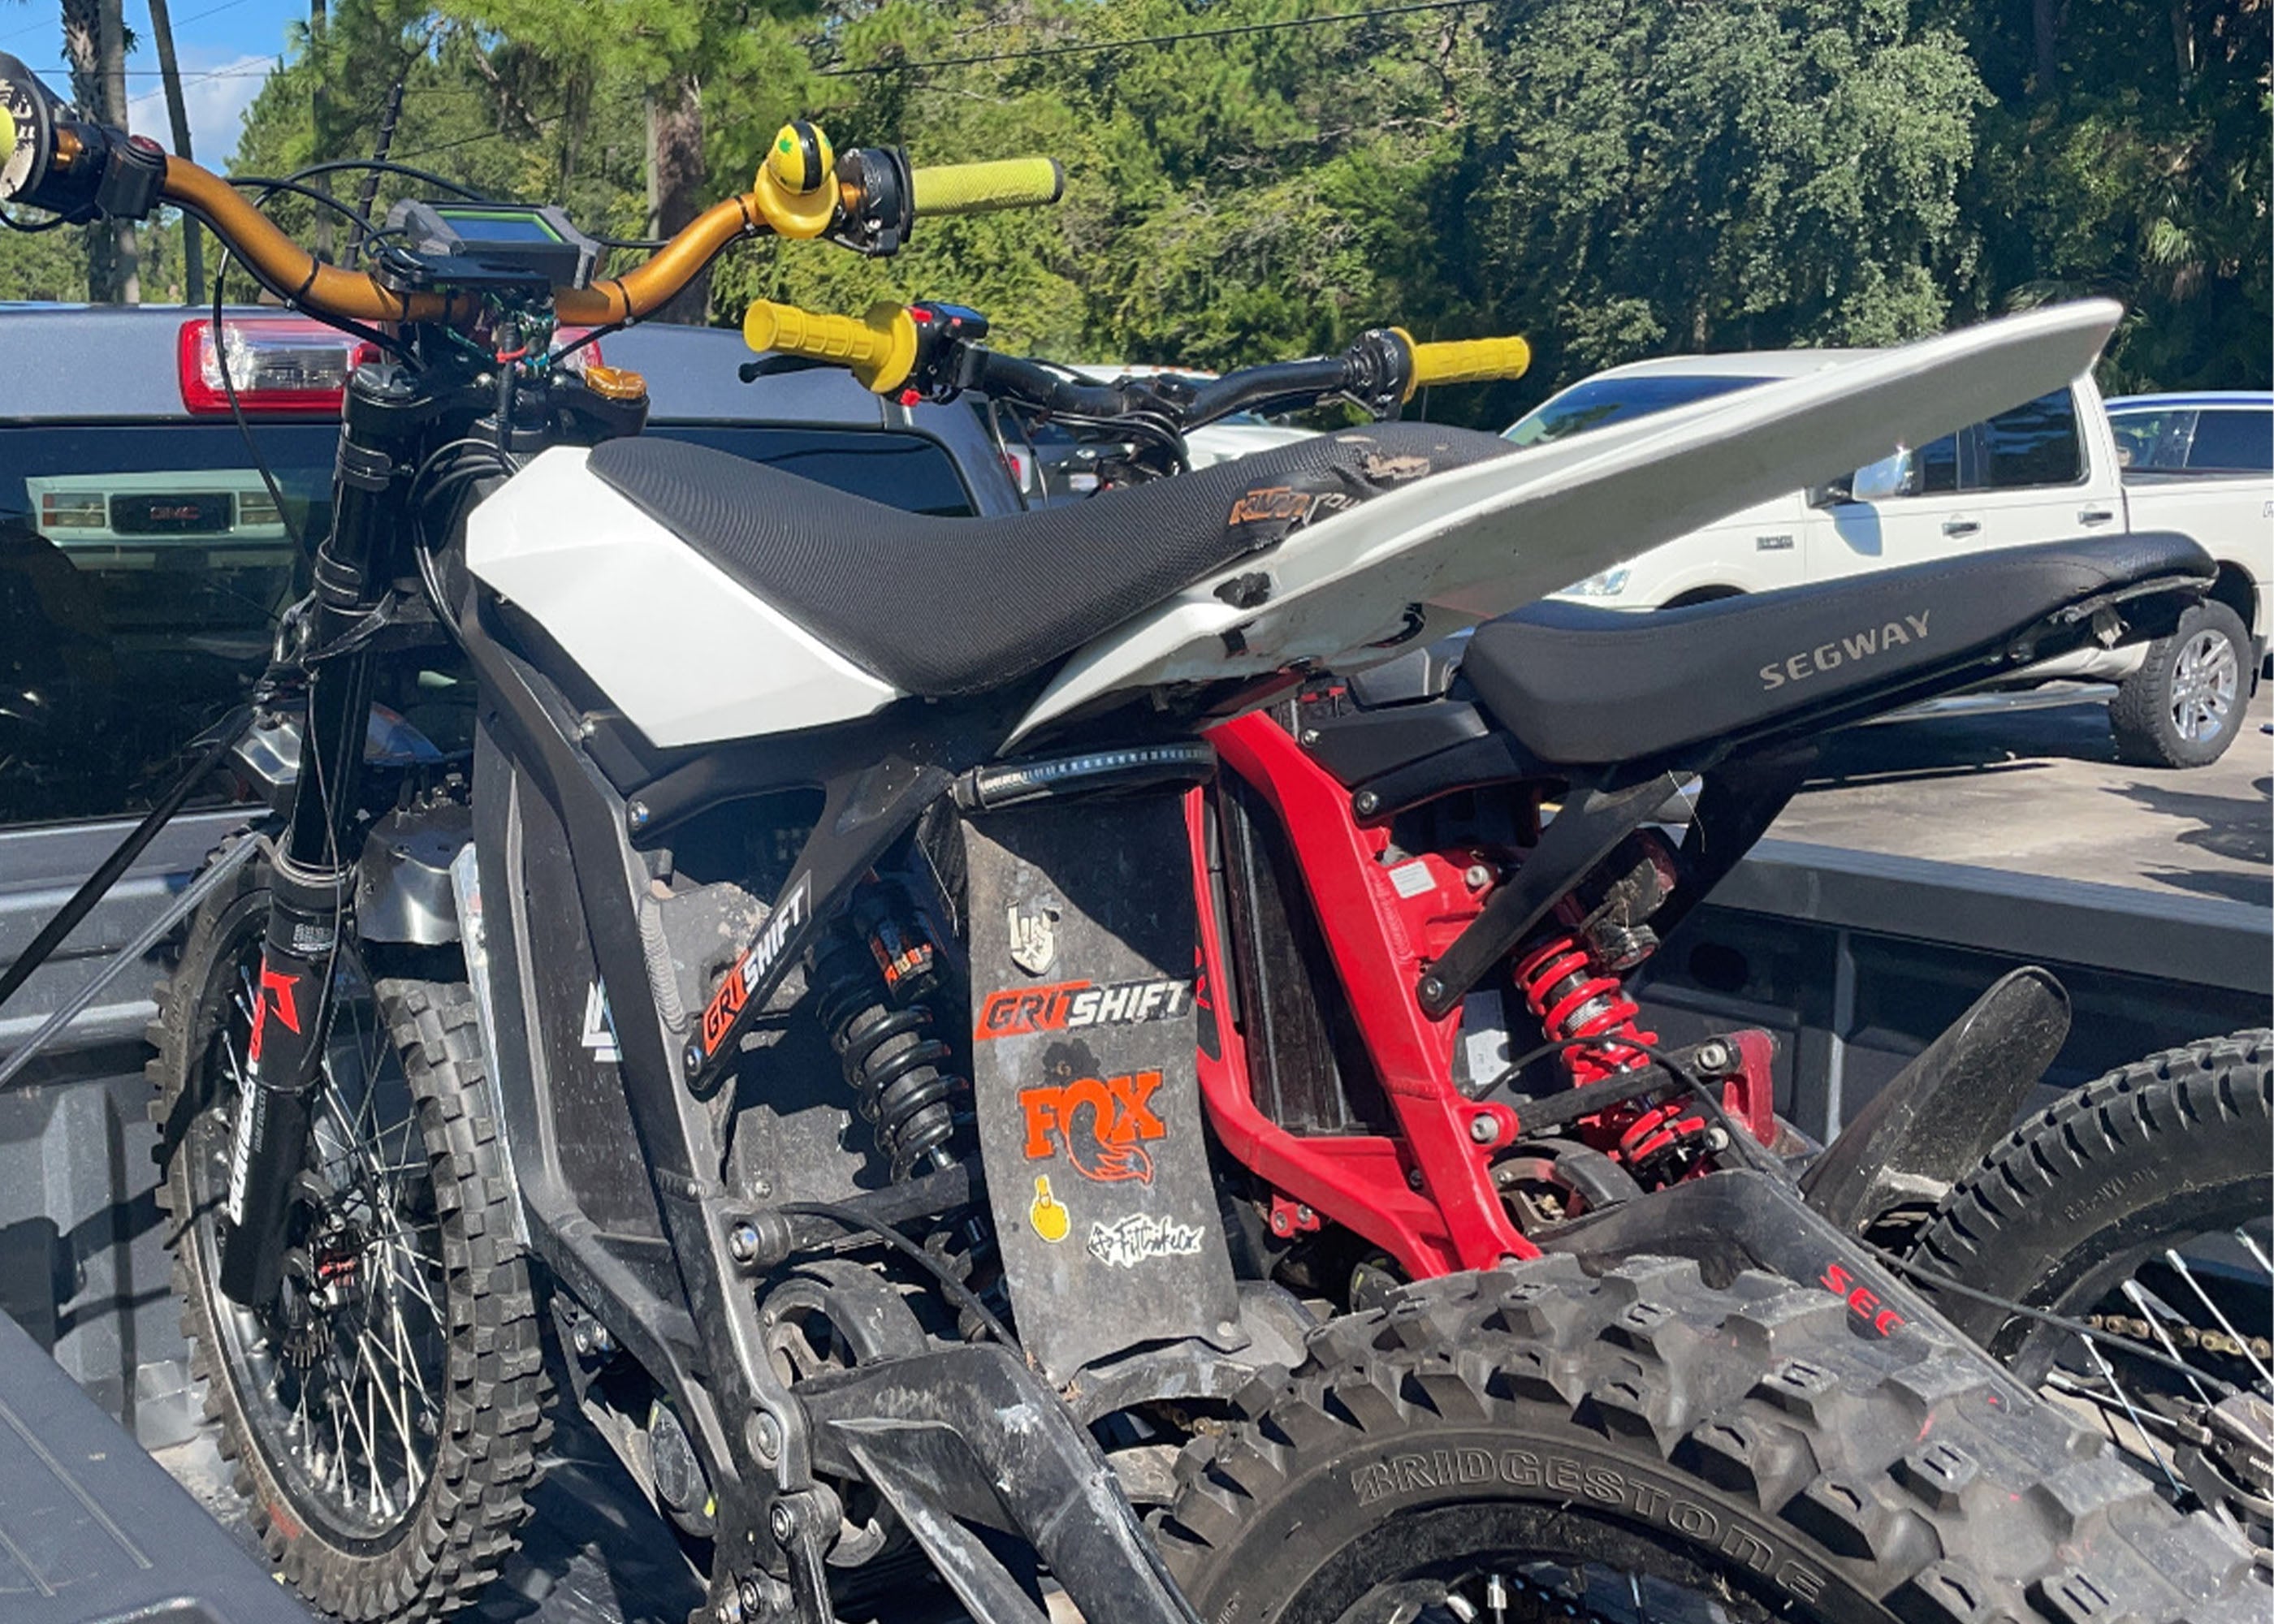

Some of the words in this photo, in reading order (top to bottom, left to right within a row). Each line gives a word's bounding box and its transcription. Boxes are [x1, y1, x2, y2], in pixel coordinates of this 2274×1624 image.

[1758, 609, 1932, 691] SEGWAY
[706, 886, 805, 1042] GRITSHIFT
[987, 981, 1187, 1032] GRITSHIFT
[1018, 1069, 1167, 1186] FOX
[1350, 1447, 1827, 1605] BRIDGESTONE
